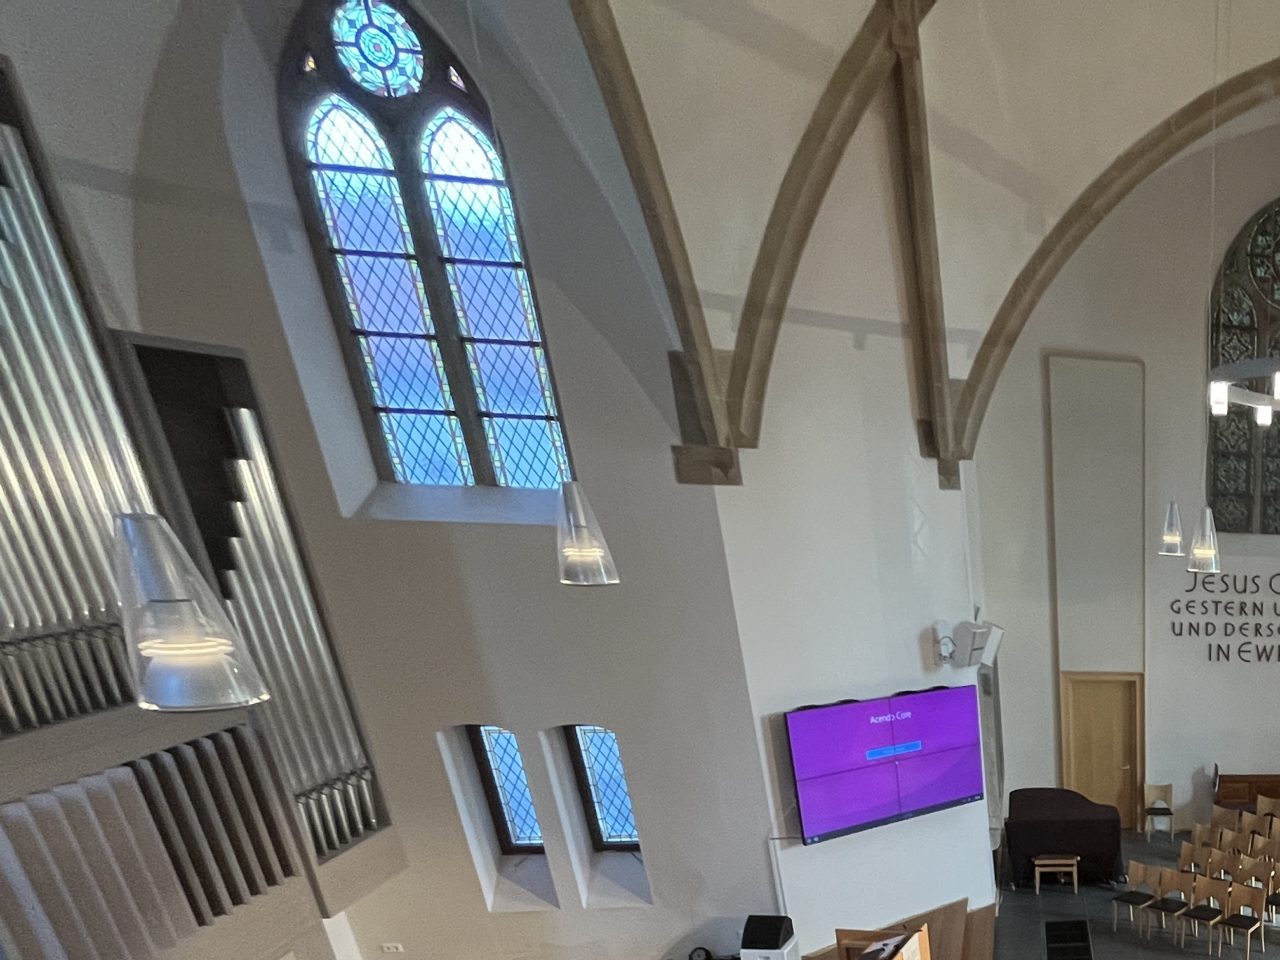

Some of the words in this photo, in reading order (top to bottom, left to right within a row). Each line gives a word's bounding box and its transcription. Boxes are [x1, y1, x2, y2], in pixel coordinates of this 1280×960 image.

[1185, 571, 1261, 594] JESUS
[1170, 600, 1264, 617] GESTERN
[1171, 621, 1216, 637] UND
[1208, 644, 1230, 662] IN
